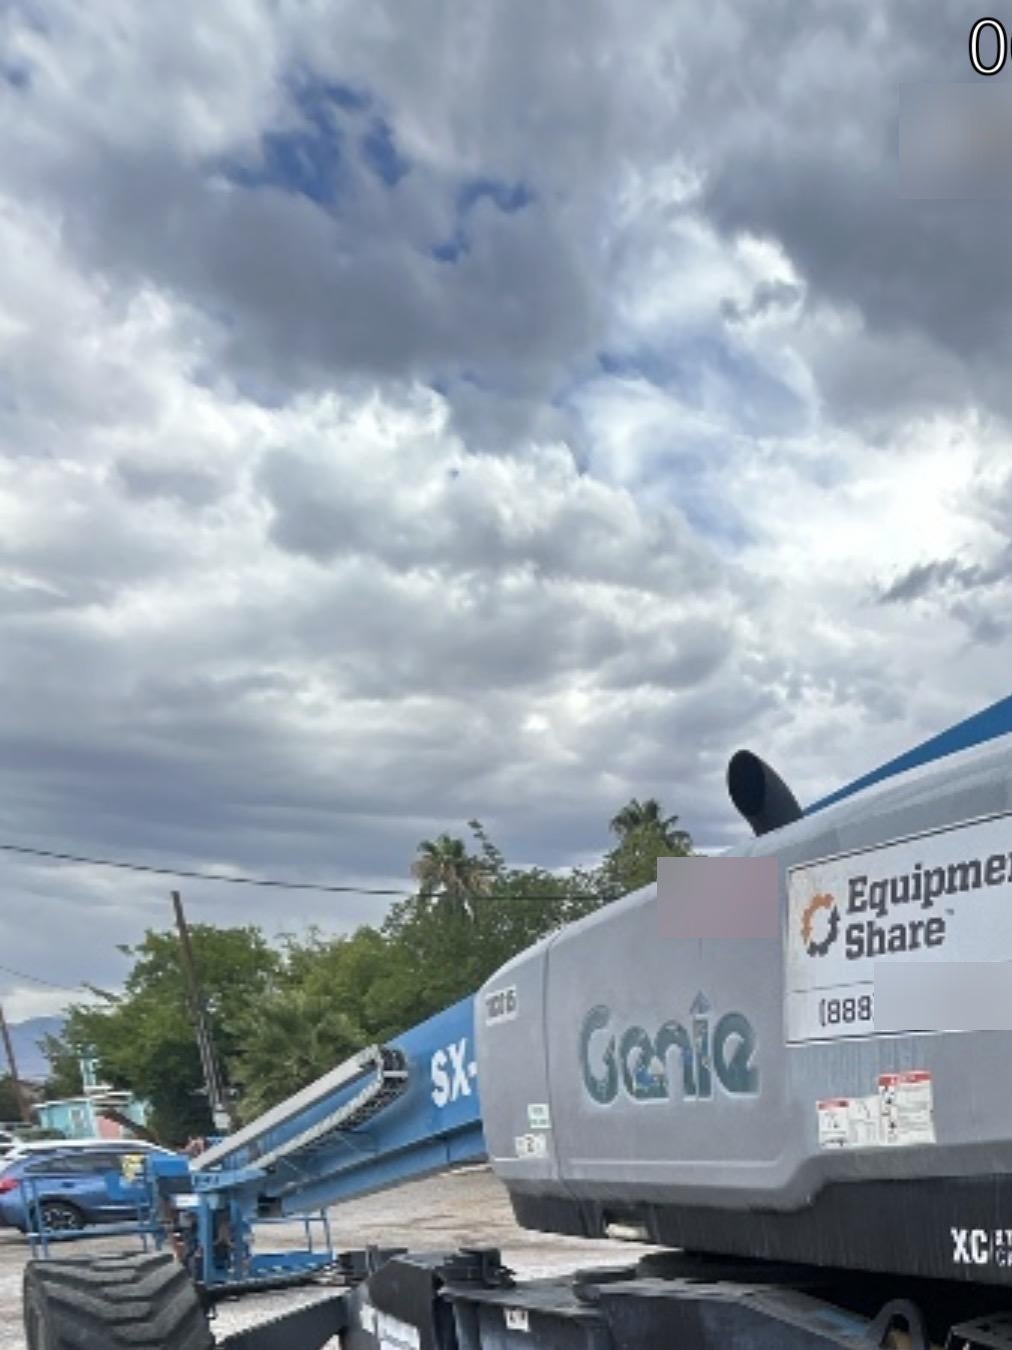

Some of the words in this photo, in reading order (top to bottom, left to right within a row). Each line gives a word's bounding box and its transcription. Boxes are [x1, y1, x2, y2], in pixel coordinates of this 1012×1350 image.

[846, 914, 945, 959] Share
[821, 993, 874, 1027] (888
[581, 989, 760, 1105] Genie
[951, 1226, 988, 1264] XC
